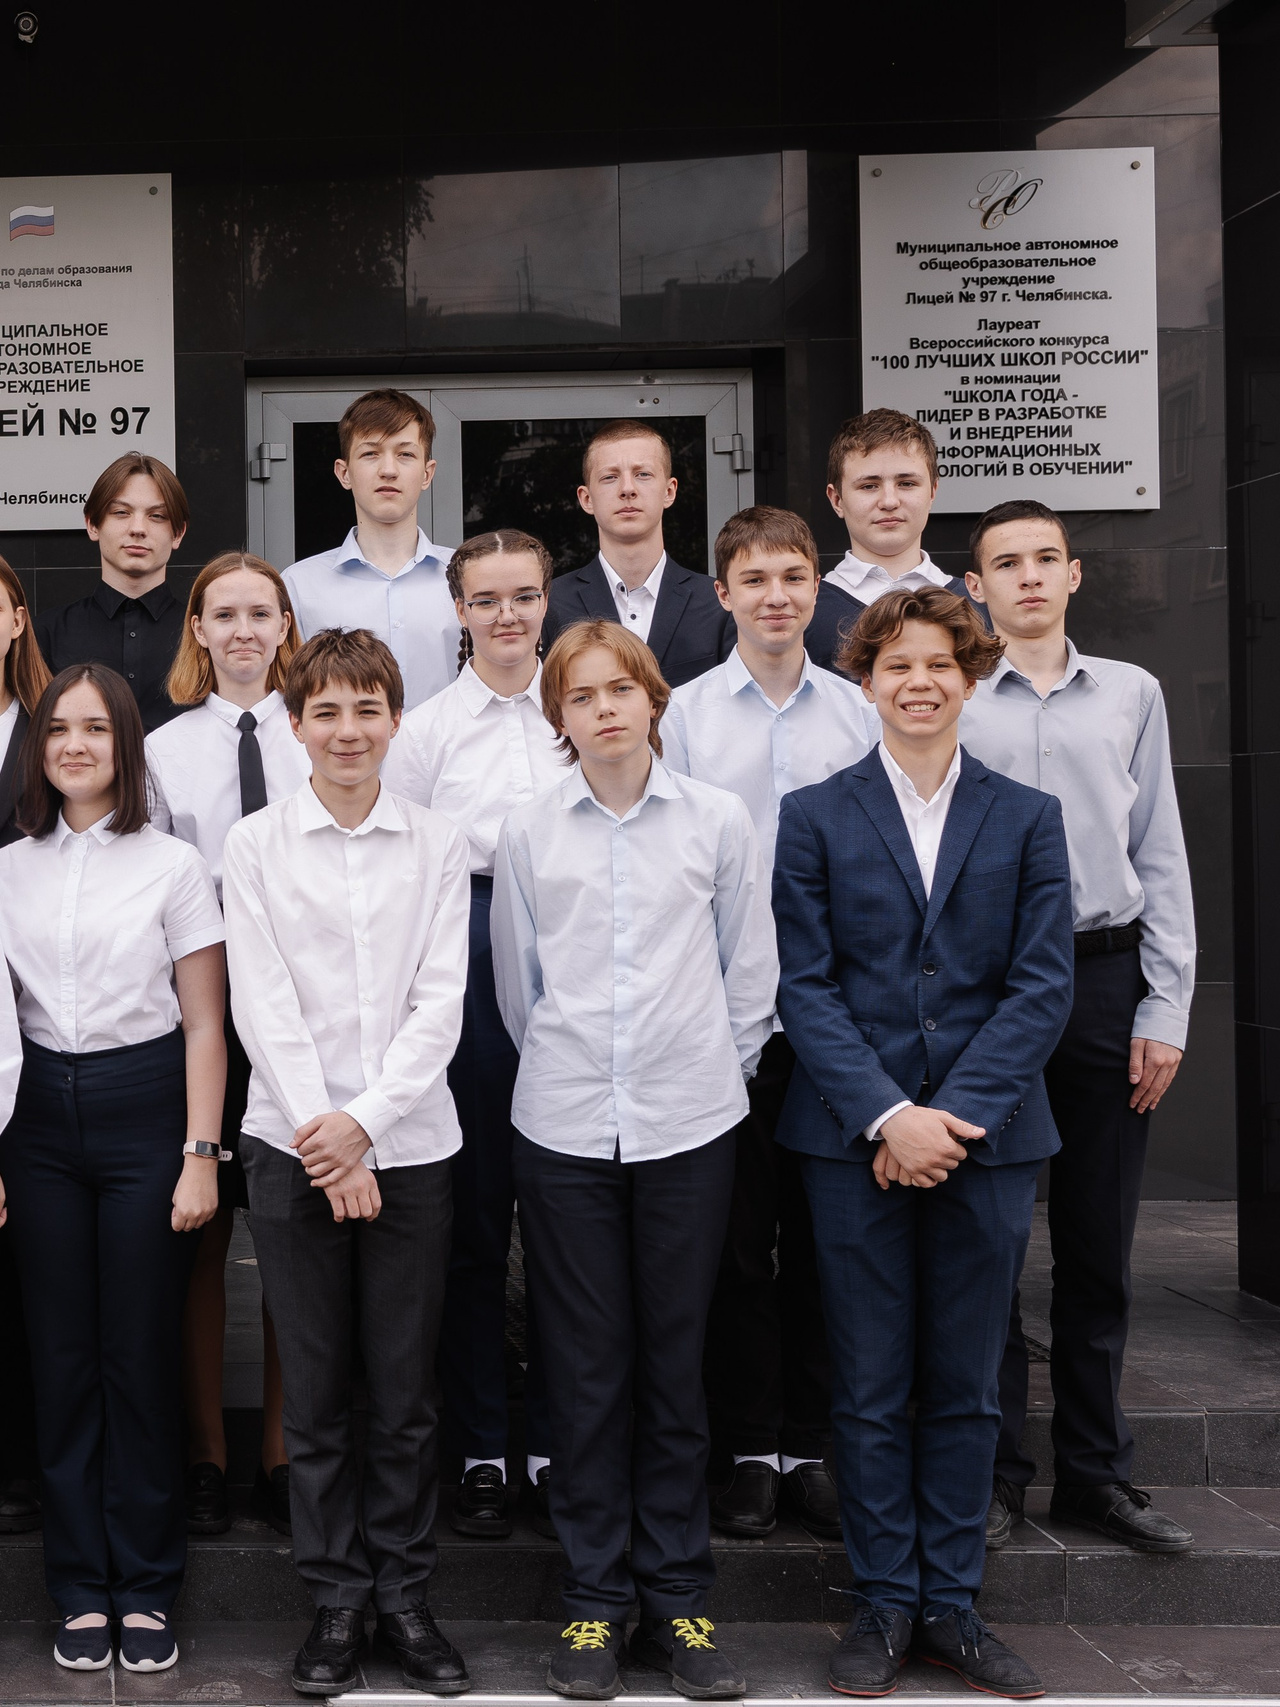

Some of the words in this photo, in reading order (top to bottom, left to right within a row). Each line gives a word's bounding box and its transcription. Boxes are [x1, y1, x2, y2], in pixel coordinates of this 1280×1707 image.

[897, 242, 1021, 256] Муниципальное
[1025, 240, 1118, 250] автономное
[919, 254, 1096, 271] общеобразовательное
[18, 268, 54, 277] делам
[58, 265, 132, 276] образования
[14, 278, 82, 288] Челябинска
[962, 275, 1055, 289] учреждение
[906, 292, 953, 305] Лицей
[959, 291, 975, 303] №
[980, 291, 997, 302] 97
[1002, 293, 1010, 302] г.
[1016, 289, 1112, 301] Челябинска.
[977, 319, 1040, 333] Лауреат
[910, 336, 1035, 351] Всероссийского
[1040, 336, 1109, 348] конкурса
[872, 355, 909, 369] "100
[915, 353, 995, 368] ЛУЧШИХ
[1001, 352, 1055, 366] ШКОЛ
[1062, 350, 1148, 365] РОССИИ"
[961, 376, 969, 385] в
[975, 374, 1060, 385] номинации
[945, 390, 1016, 403] "ШКОЛА
[1022, 389, 1067, 404] ГОДА
[59, 408, 96, 435] №
[111, 407, 150, 435] 97
[979, 409, 990, 421] В
[996, 406, 1106, 420] РАЗРАБОТКЕ
[950, 427, 960, 440] И
[967, 425, 1072, 441] ВНЕДРЕНИИ
[936, 444, 1101, 460] НФОРМАЦИОННЫХ
[937, 461, 1008, 477] ОЛОГИЙ
[1013, 463, 1024, 476] В
[1029, 461, 1132, 475] ОБУЧЕНИИ"
